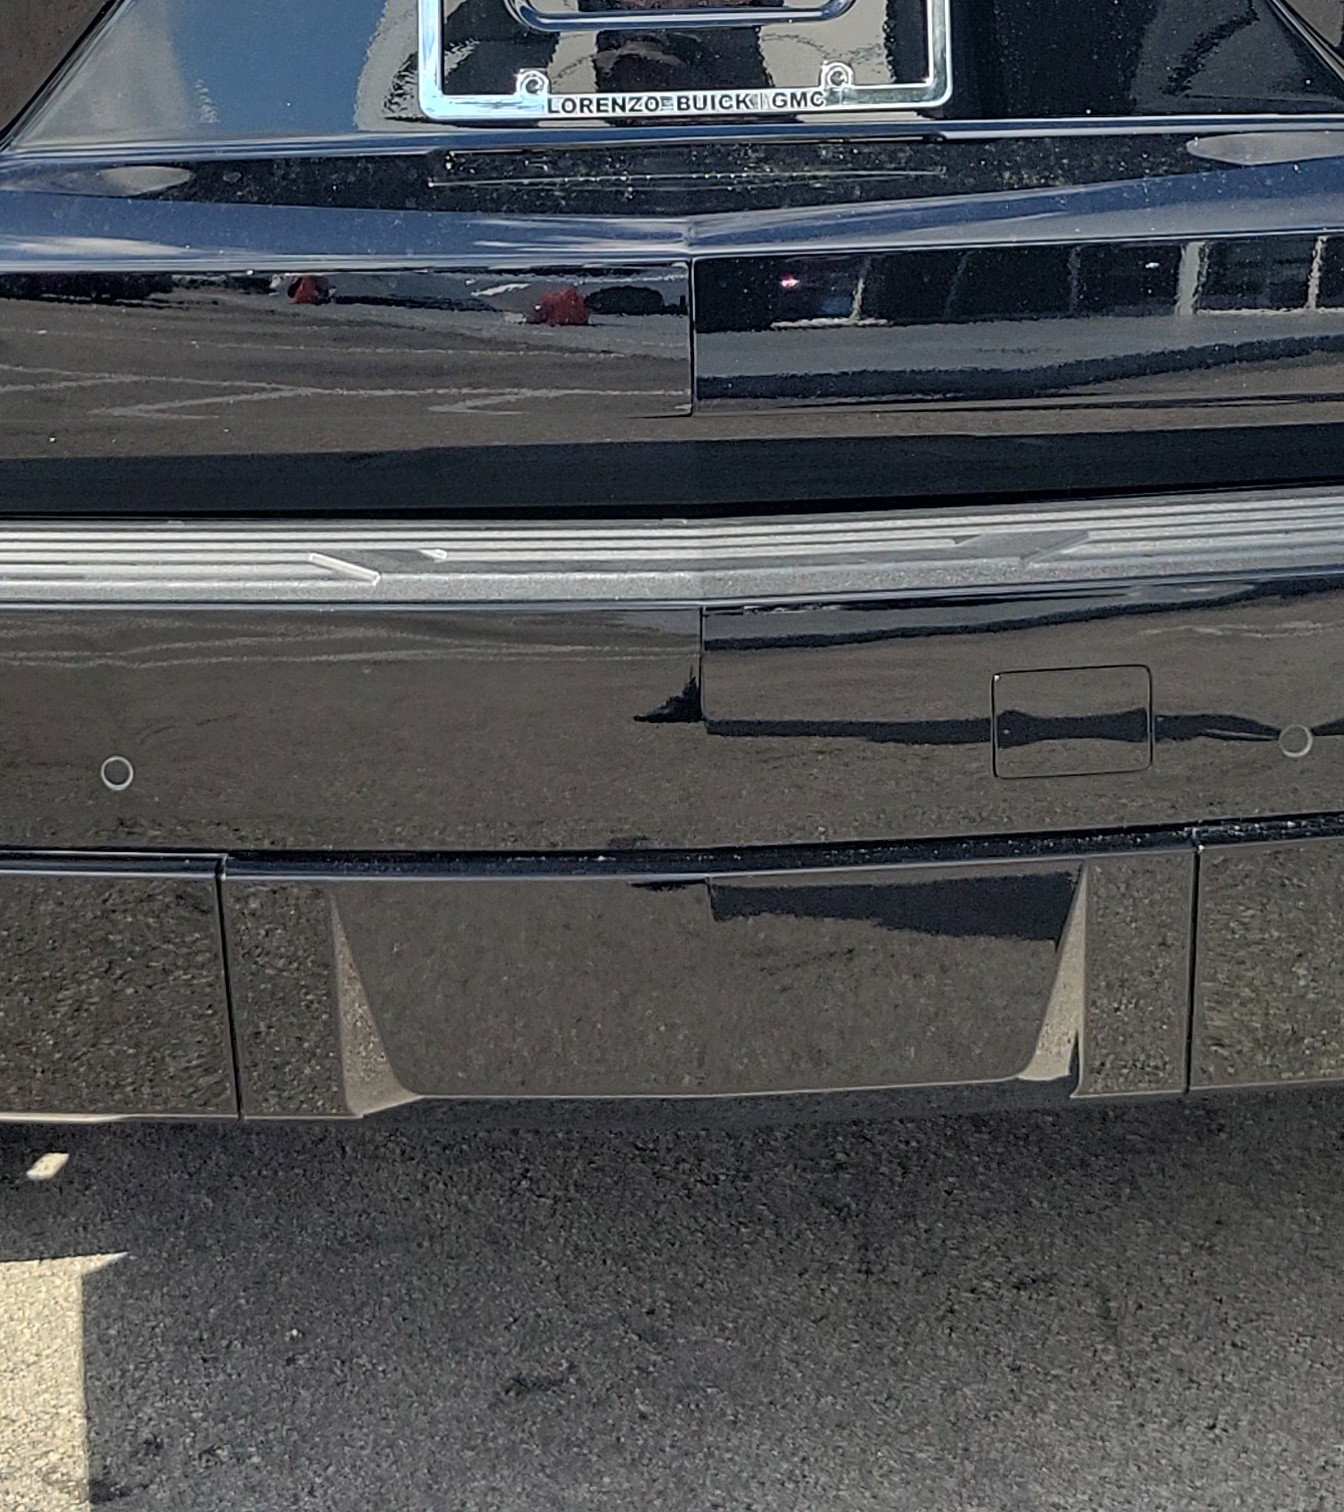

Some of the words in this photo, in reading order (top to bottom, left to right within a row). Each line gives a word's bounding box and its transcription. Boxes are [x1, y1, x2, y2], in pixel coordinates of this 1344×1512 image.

[547, 95, 660, 114] LORENZO
[676, 92, 752, 111] BUICK
[772, 90, 825, 108] GMC
